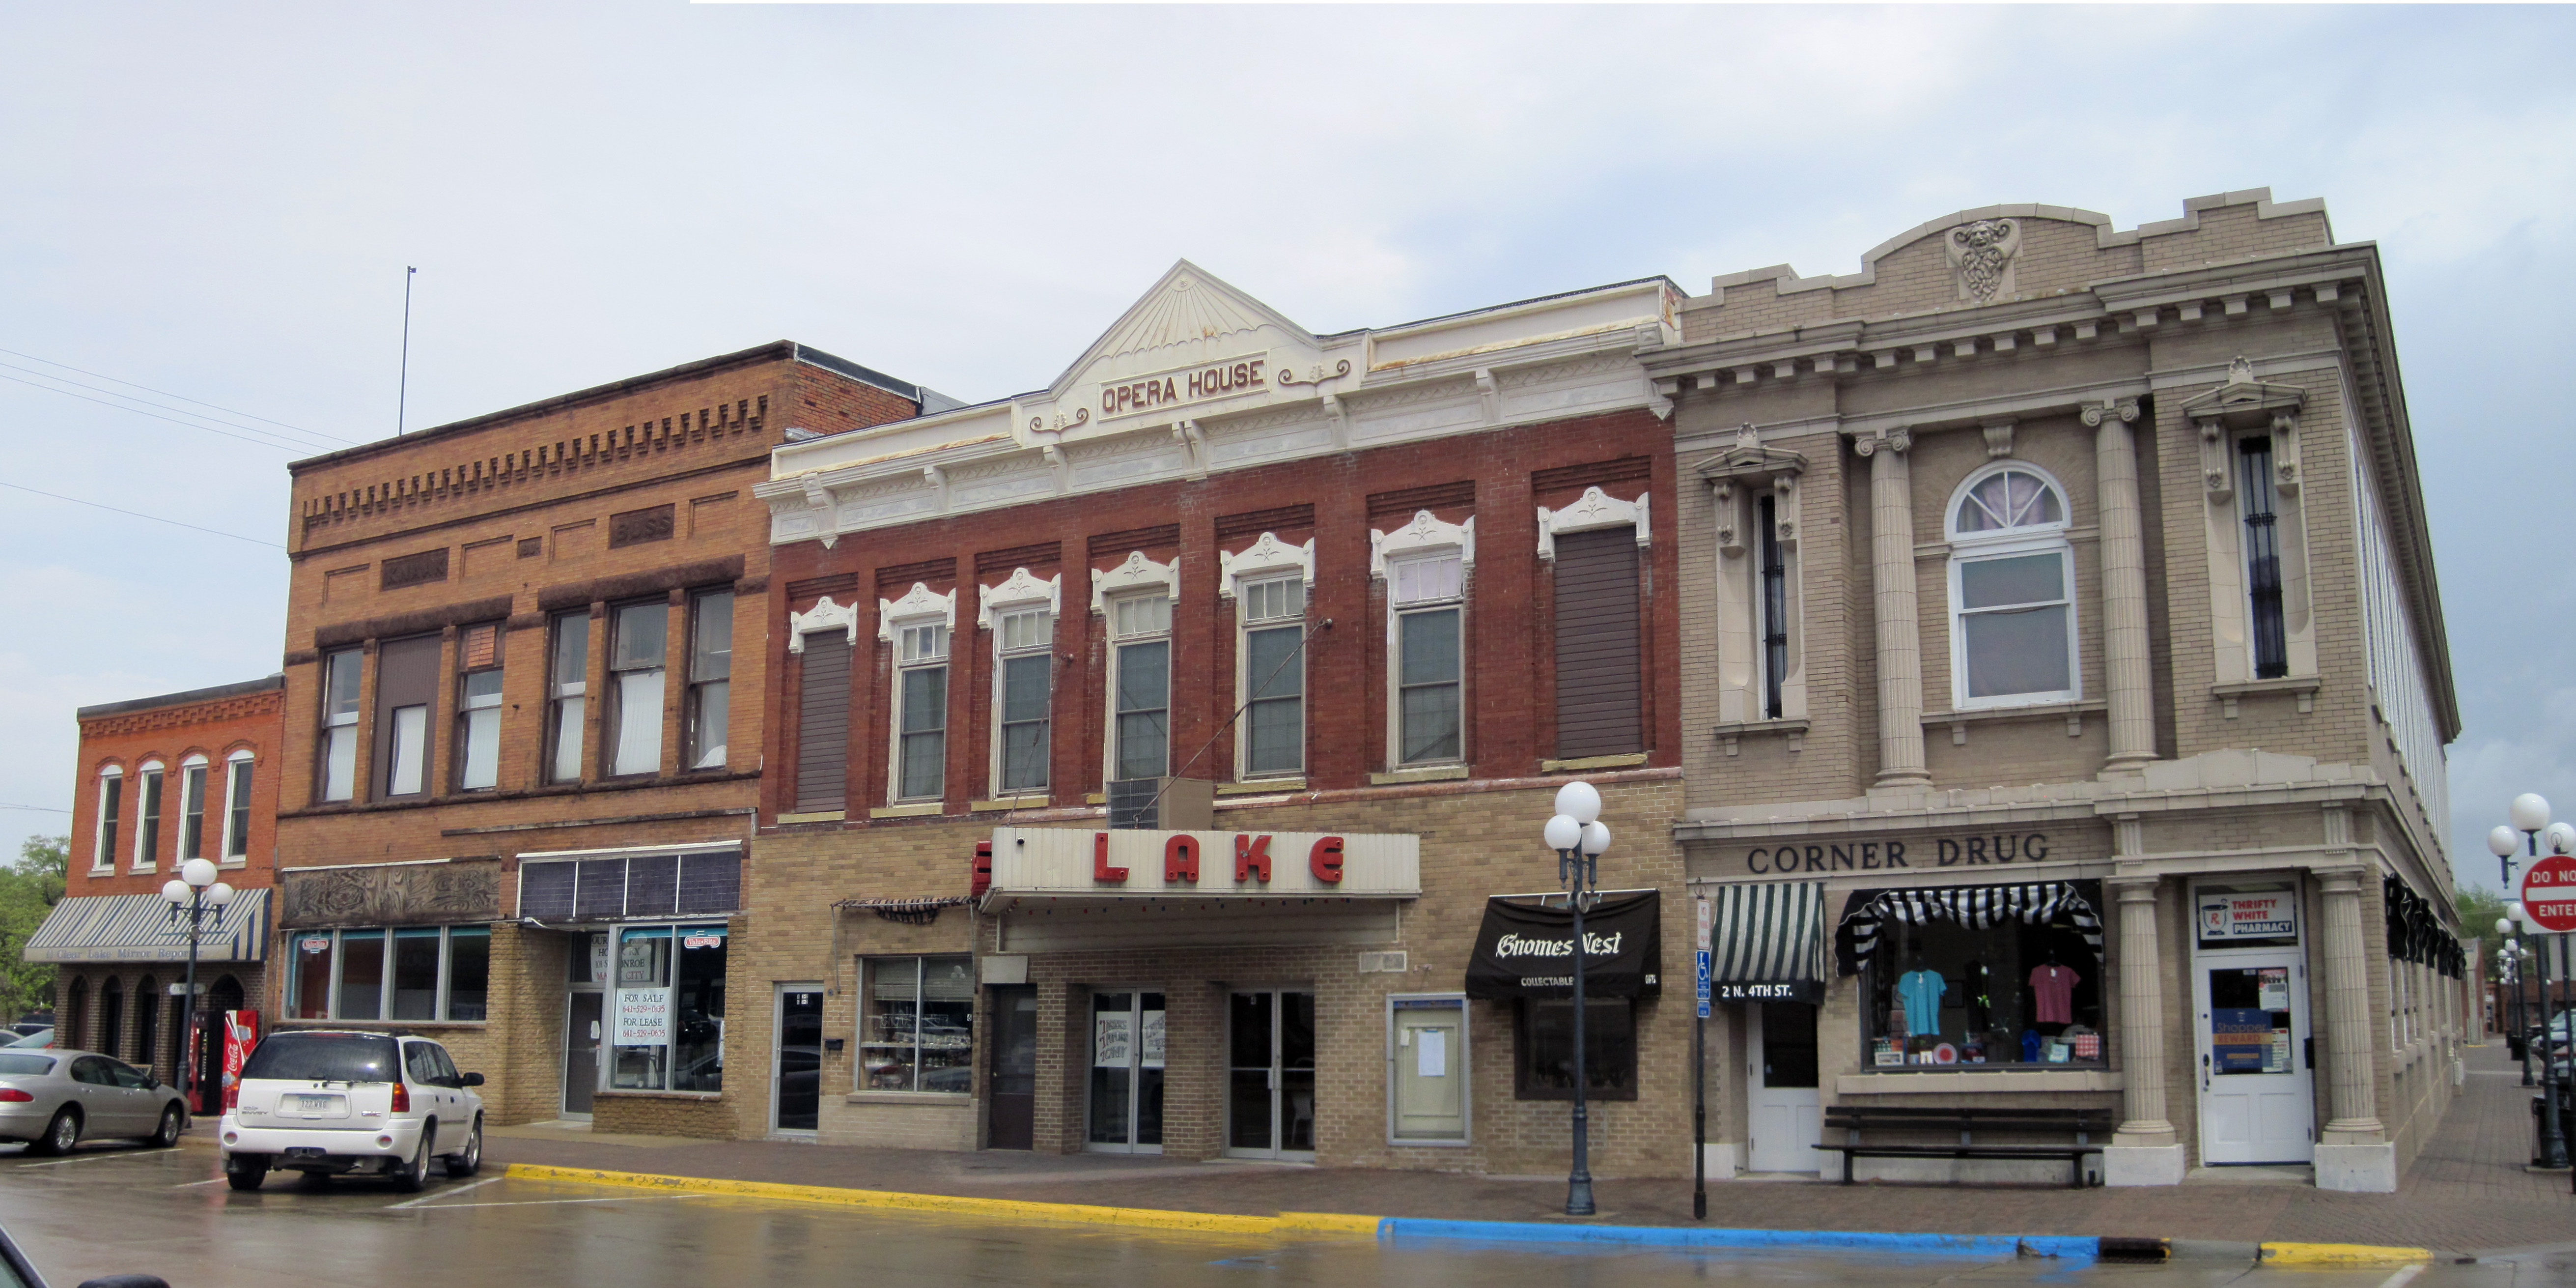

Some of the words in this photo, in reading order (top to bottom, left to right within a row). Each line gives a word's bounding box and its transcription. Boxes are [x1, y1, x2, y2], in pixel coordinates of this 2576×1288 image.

[1102, 377, 1177, 412] OPERA
[1188, 360, 1264, 396] HOUSE
[1093, 831, 1344, 883] LAKE
[1748, 841, 1908, 874] CORNER
[1937, 834, 2049, 866] DRUG
[2532, 871, 2551, 883] DO
[2558, 870, 2576, 882] NO
[2232, 898, 2277, 909] THRIFTY
[2233, 910, 2268, 920] WHITE
[2539, 904, 2576, 916] ENTE
[2235, 922, 2291, 934] PHARMACY
[1496, 932, 1574, 958] Gnomes
[57, 949, 82, 959] Clear
[88, 949, 111, 958] Lake
[118, 948, 151, 958] Mirror
[596, 972, 607, 980] MA
[626, 971, 644, 979] CITY
[1722, 986, 1730, 998] 2
[1733, 985, 1745, 997] N.
[1748, 985, 1771, 997] 4TH
[1774, 984, 1792, 997] ST.
[624, 994, 638, 1002] FOR
[643, 994, 664, 1002] SALE
[623, 1018, 636, 1026] FOR
[639, 1017, 663, 1026] LEASE
[2217, 1023, 2267, 1033] Shopper
